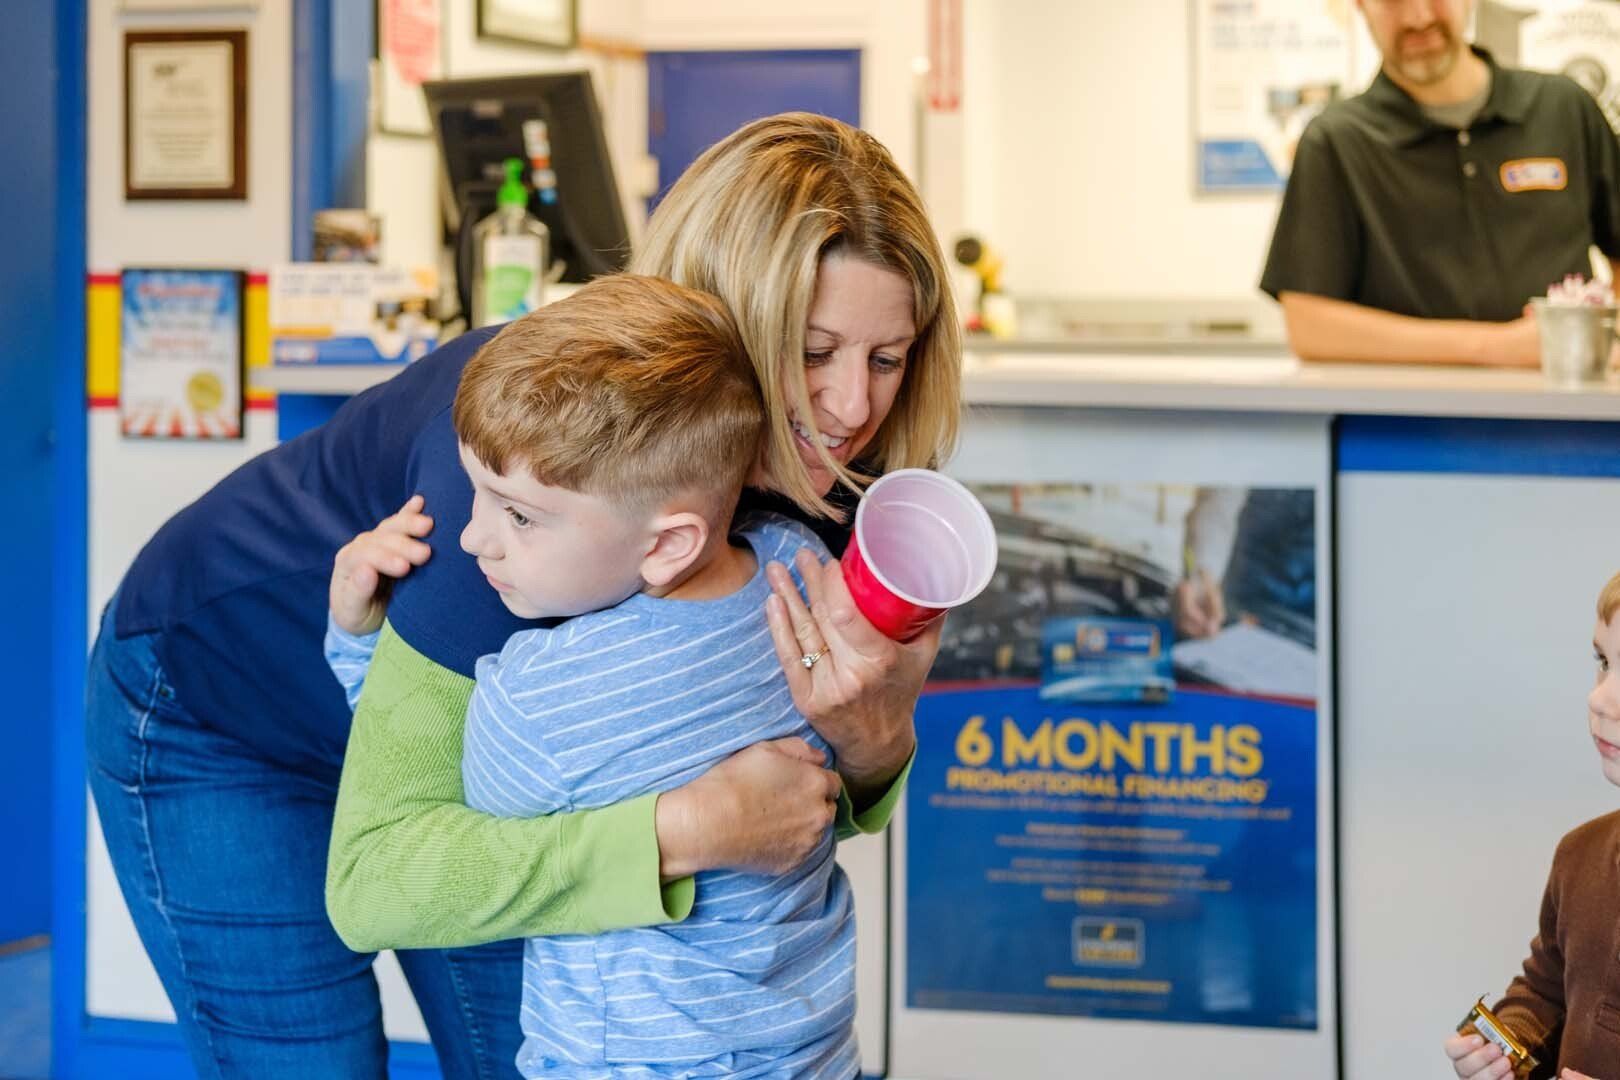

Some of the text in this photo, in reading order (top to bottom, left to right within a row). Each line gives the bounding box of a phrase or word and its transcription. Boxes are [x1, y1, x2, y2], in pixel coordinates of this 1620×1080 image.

[955, 716, 1264, 777] 6 MONTHS
[946, 767, 1118, 798] PROMOTIONAL
